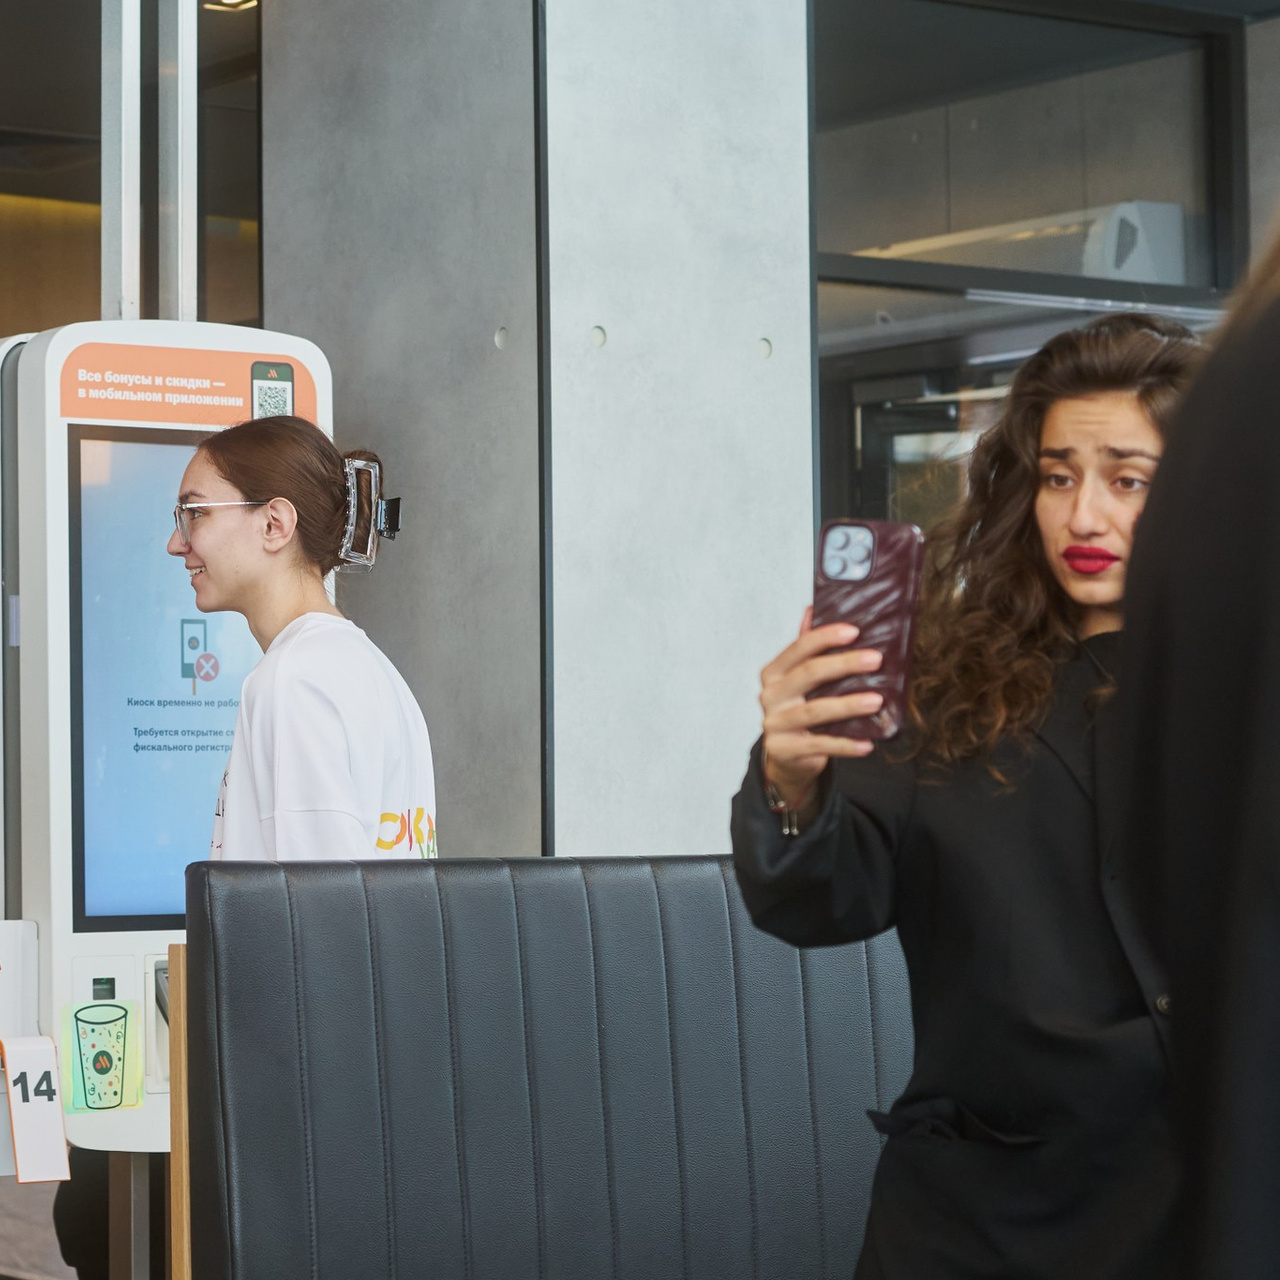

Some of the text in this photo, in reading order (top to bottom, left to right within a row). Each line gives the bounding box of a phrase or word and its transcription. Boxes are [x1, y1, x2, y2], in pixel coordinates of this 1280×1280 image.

[78, 369, 102, 382] Все
[104, 371, 152, 386] бонусы
[155, 377, 162, 385] и
[165, 378, 211, 389] скидки
[78, 387, 244, 407] в мобильном приложении
[127, 697, 155, 706] Киоск
[157, 699, 202, 708] временно
[217, 699, 240, 709] рабо
[133, 727, 179, 738] Требуется
[181, 729, 224, 738] открытие
[133, 742, 193, 753] фискального
[12, 1071, 57, 1102] 14
